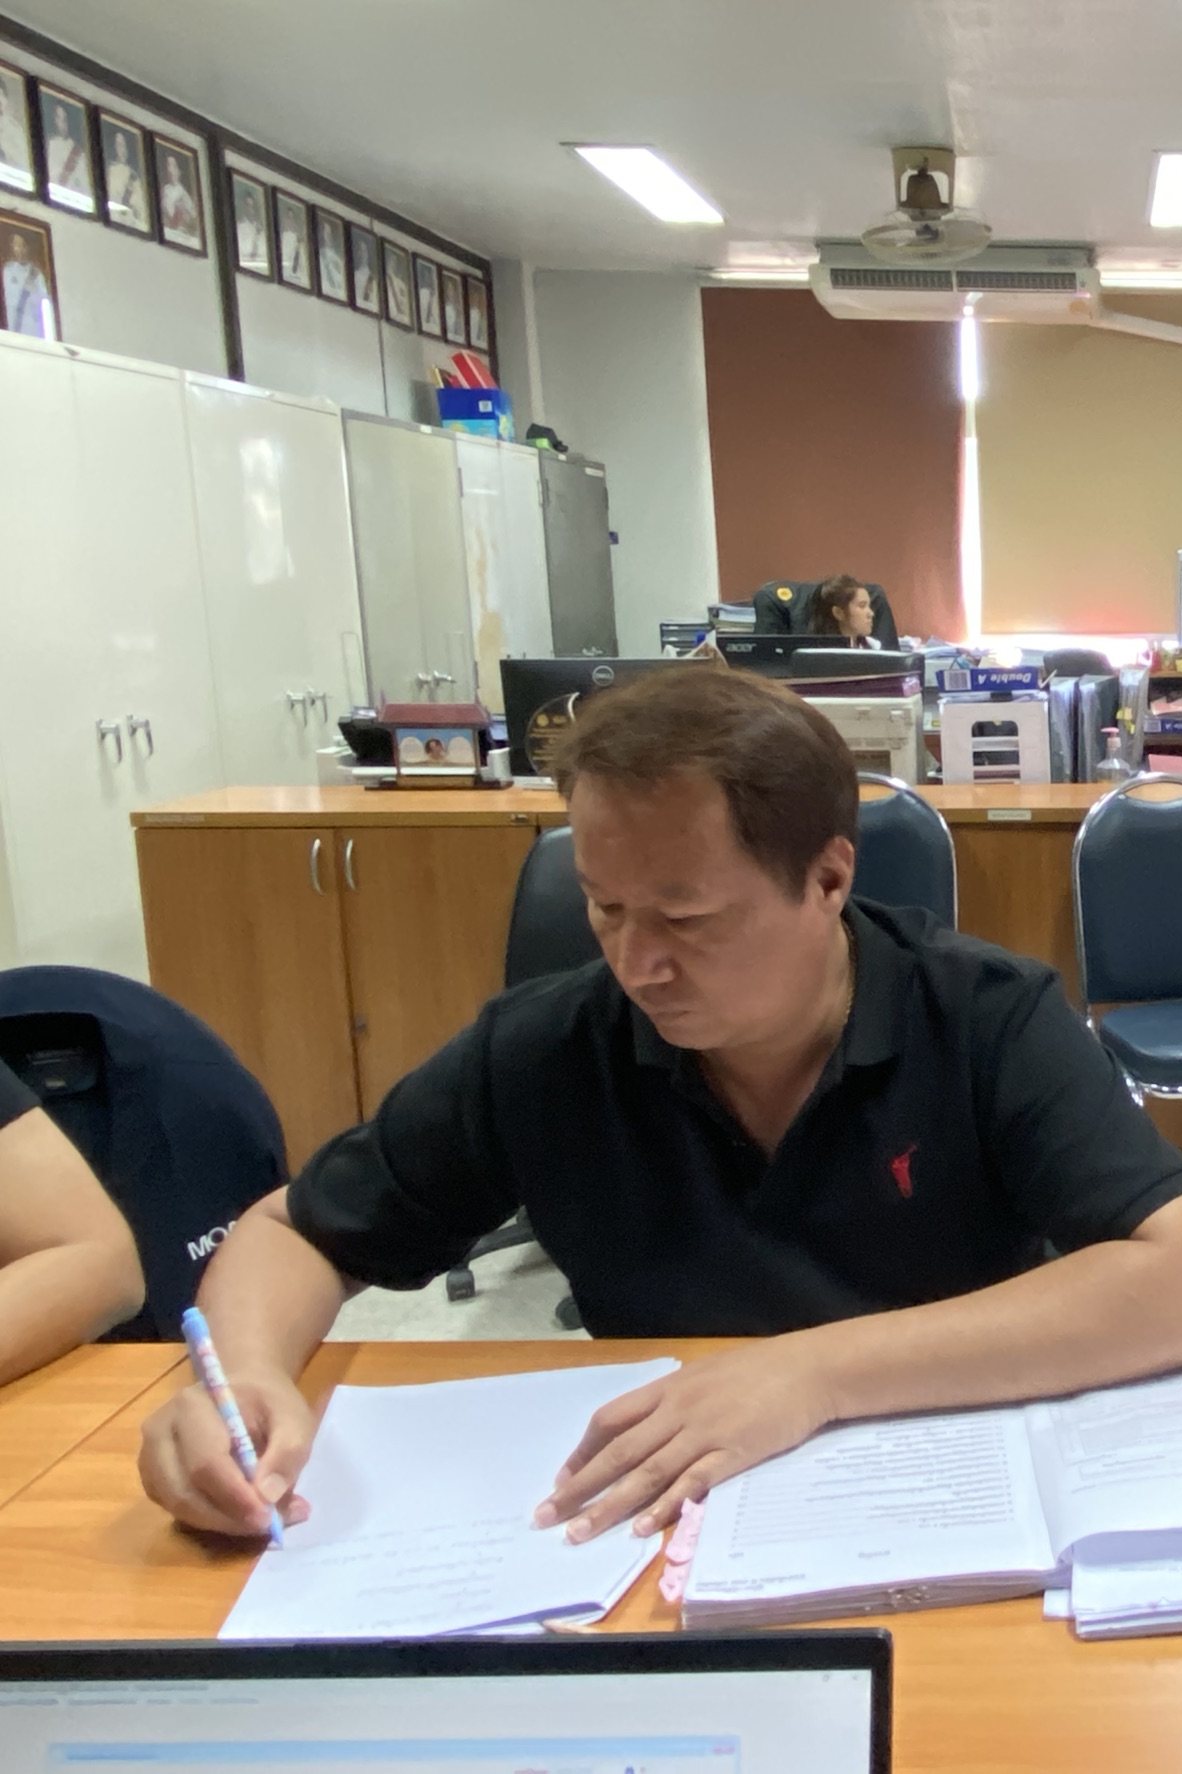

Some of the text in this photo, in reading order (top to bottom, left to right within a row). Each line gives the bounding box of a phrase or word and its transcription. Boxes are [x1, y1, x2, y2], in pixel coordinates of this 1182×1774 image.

[726, 643, 757, 652] acer
[977, 672, 1032, 684] Double A
